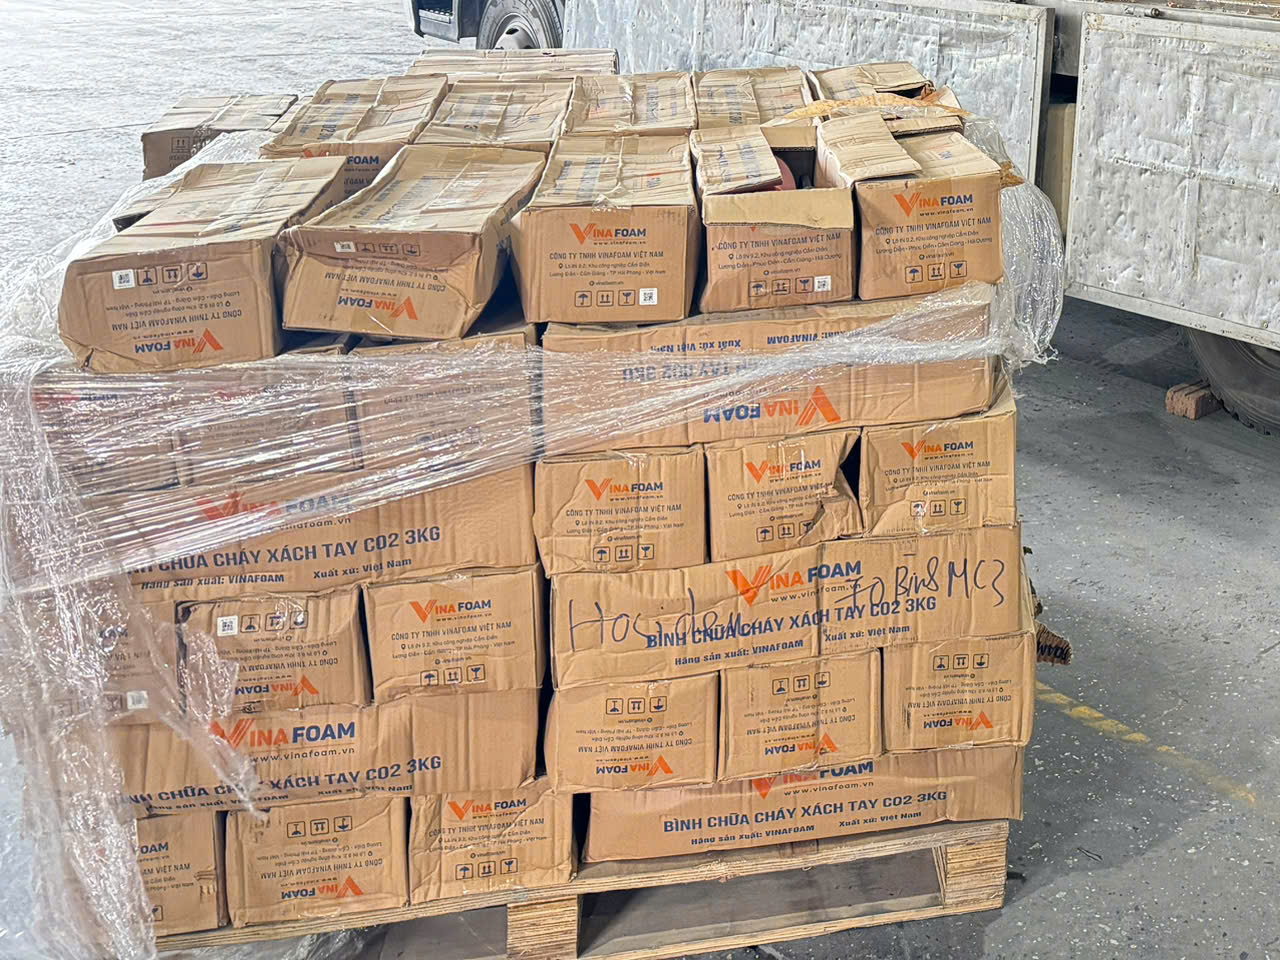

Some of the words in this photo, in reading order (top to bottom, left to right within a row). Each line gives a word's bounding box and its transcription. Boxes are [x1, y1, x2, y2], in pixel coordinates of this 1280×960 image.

[894, 191, 974, 217] VINAFOAM
[569, 223, 647, 246] VINAFOAM
[876, 225, 892, 235] CÔNG
[894, 224, 904, 234] TY
[906, 223, 924, 233] TNHH
[925, 220, 959, 231] VINAFOAM
[961, 217, 976, 229] VIỆT
[977, 216, 992, 225] NAM
[549, 250, 565, 260] CÔNG
[566, 251, 576, 260] TY
[578, 251, 596, 260] TNHH
[597, 251, 631, 260] VINAFOAM
[633, 250, 647, 260] VIỆT
[648, 251, 664, 260] NAM
[337, 295, 418, 321] VINAFOAM
[134, 327, 223, 354] VINAFOAM
[677, 342, 696, 353] Việt
[718, 339, 741, 349] Xuất
[704, 385, 842, 426] VINAFOAM
[901, 439, 974, 460] VINAFOAM
[745, 459, 821, 484] VINAFOAM
[585, 478, 664, 502] VINAFOAM
[213, 546, 260, 568] CHÁY
[267, 542, 318, 563] XÁCH
[321, 539, 358, 559] TAY
[405, 526, 441, 546] 3KG
[229, 573, 285, 584] VINAFOAM
[313, 567, 338, 580] Xuất
[362, 561, 382, 573] Việt
[386, 557, 412, 569] Nam
[725, 560, 861, 607] VINAFOAM
[409, 598, 491, 624] VINAFOAM
[647, 629, 687, 649] BÌNH
[691, 622, 738, 645] CHỮA
[741, 614, 785, 637] CHÁY
[790, 609, 830, 631] XÁCH
[834, 604, 866, 624] TAY
[905, 595, 936, 613] 3KG
[825, 631, 847, 642] Xuất
[867, 627, 887, 638] Việt
[889, 625, 910, 634] Nam
[675, 656, 700, 667] Hãng
[703, 653, 721, 662] sản
[724, 648, 749, 660] xuất:
[752, 639, 803, 655] VINAFOAM
[235, 674, 320, 697] VINAFOAM
[923, 711, 993, 730] VINAFOAM
[209, 718, 355, 749] VINAFOAM
[765, 733, 838, 756] VINAFOAM
[250, 747, 355, 762] www.vinafoam.vn
[596, 755, 674, 777] VINAFOAM
[158, 783, 209, 802] CHỮA
[271, 772, 320, 791] XÁCH
[324, 771, 361, 786] TAY
[406, 755, 442, 774] 3KG
[784, 781, 874, 797] www.vinafoam.vn
[447, 798, 527, 821] VINAFOAM
[663, 815, 702, 833] BÌNH
[707, 811, 750, 829] CHỮA
[754, 806, 797, 824] CHÁY
[801, 799, 844, 818] XÁCH
[847, 798, 879, 811] TAY
[917, 791, 947, 803] 3KG
[839, 818, 861, 828] Xuất
[880, 813, 898, 823] Việt
[900, 811, 922, 820] Nam
[691, 835, 716, 846] Hãng
[718, 833, 736, 842] sản
[739, 830, 763, 841] xuất:
[765, 825, 815, 837] VINAFOAM
[281, 875, 363, 899] VINAFOAM
